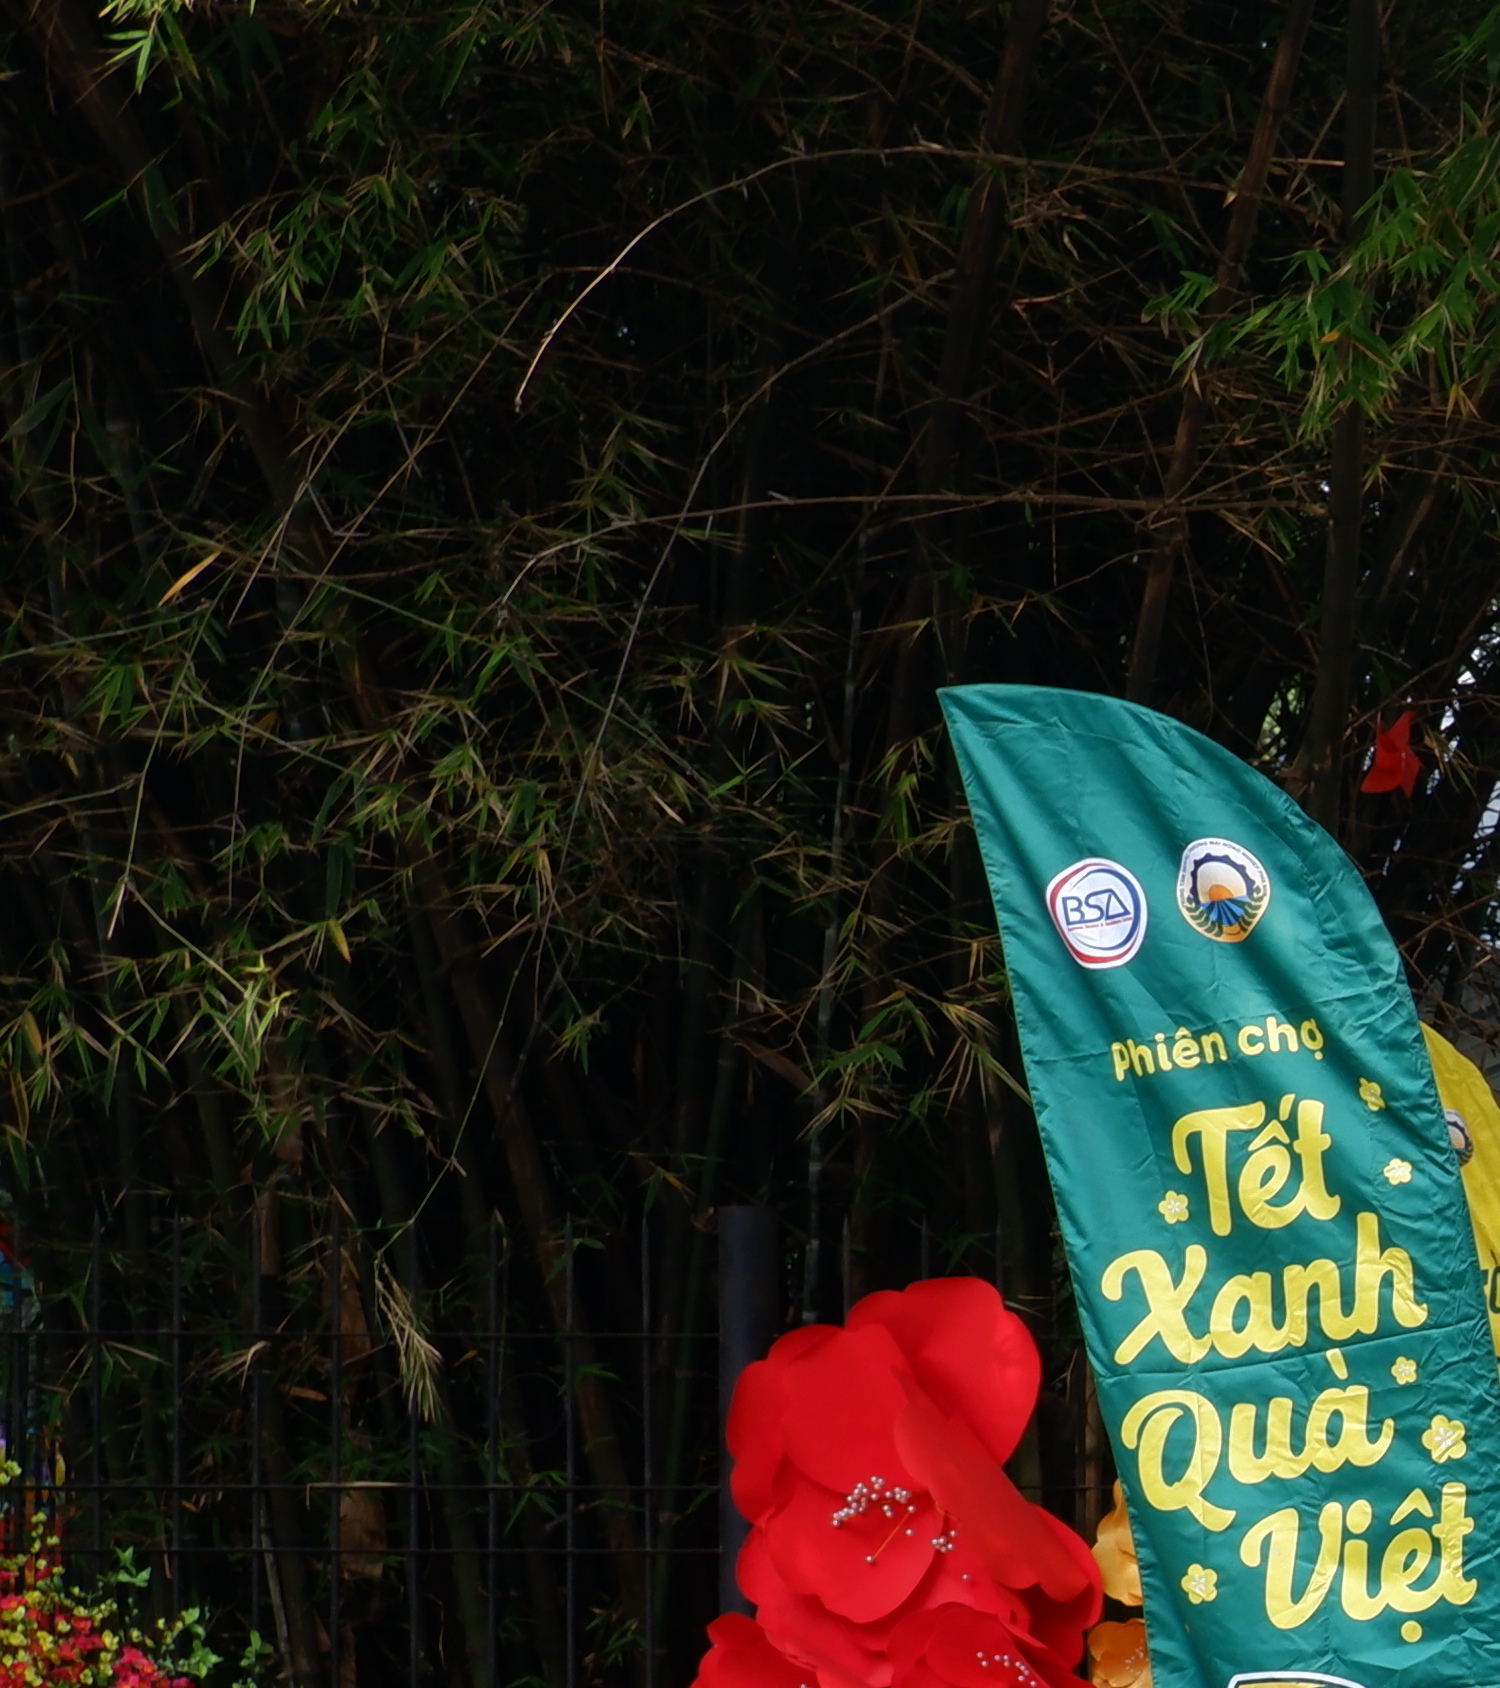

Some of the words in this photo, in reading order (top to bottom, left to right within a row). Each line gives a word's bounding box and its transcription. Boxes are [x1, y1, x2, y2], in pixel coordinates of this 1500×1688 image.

[1062, 888, 1131, 926] BSA
[1111, 1027, 1227, 1082] Phiên
[1238, 1016, 1324, 1061] chợ
[1172, 1093, 1341, 1237] Tết
[1101, 1212, 1430, 1366] Xanh
[1121, 1348, 1395, 1532] Quà
[1240, 1482, 1477, 1643] Việt
